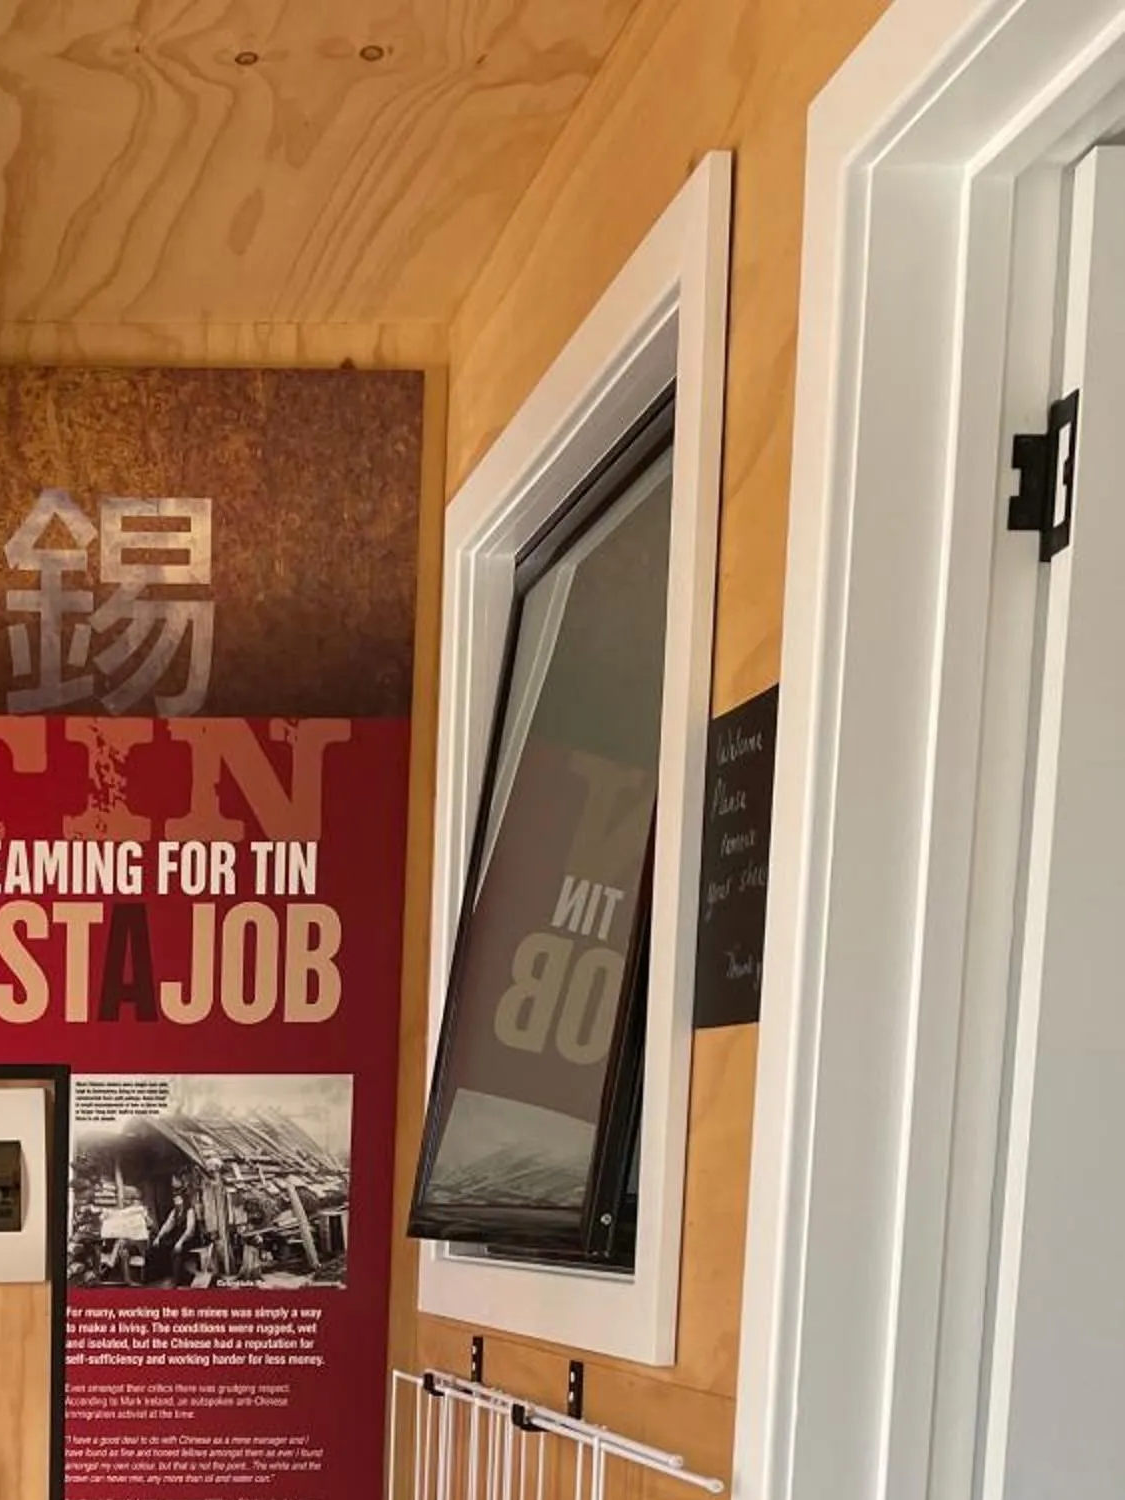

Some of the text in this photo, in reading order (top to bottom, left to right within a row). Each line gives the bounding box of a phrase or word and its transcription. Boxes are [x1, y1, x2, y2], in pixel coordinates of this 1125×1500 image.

[4, 487, 215, 717] 錫
[156, 840, 236, 896] FOR
[251, 841, 318, 896] TIN
[97, 901, 159, 1023] A
[160, 901, 342, 1025] JOB
[67, 1307, 83, 1317] For
[85, 1309, 116, 1319] many,
[119, 1307, 159, 1319] working
[163, 1307, 179, 1317] the
[197, 1307, 228, 1317] mines
[231, 1309, 252, 1317] was
[255, 1307, 288, 1319] simply
[300, 1309, 322, 1319] way
[67, 1322, 76, 1333] to
[79, 1322, 107, 1333] make
[119, 1322, 149, 1335] living.
[152, 1322, 170, 1333] The
[173, 1322, 225, 1333] conditions
[228, 1324, 254, 1333] were
[256, 1322, 295, 1335] rugged,
[297, 1322, 317, 1333] wet
[66, 1338, 85, 1349] and
[132, 1338, 149, 1349] but
[152, 1338, 168, 1349] the
[171, 1338, 211, 1349] Chinese
[213, 1338, 233, 1349] had
[245, 1338, 297, 1350] reputation
[300, 1338, 314, 1349] for
[66, 1353, 143, 1366] self-sufficiency
[146, 1353, 165, 1364] and
[168, 1353, 209, 1366] working
[213, 1353, 246, 1364] harder
[248, 1353, 263, 1364] for
[265, 1353, 286, 1364] less
